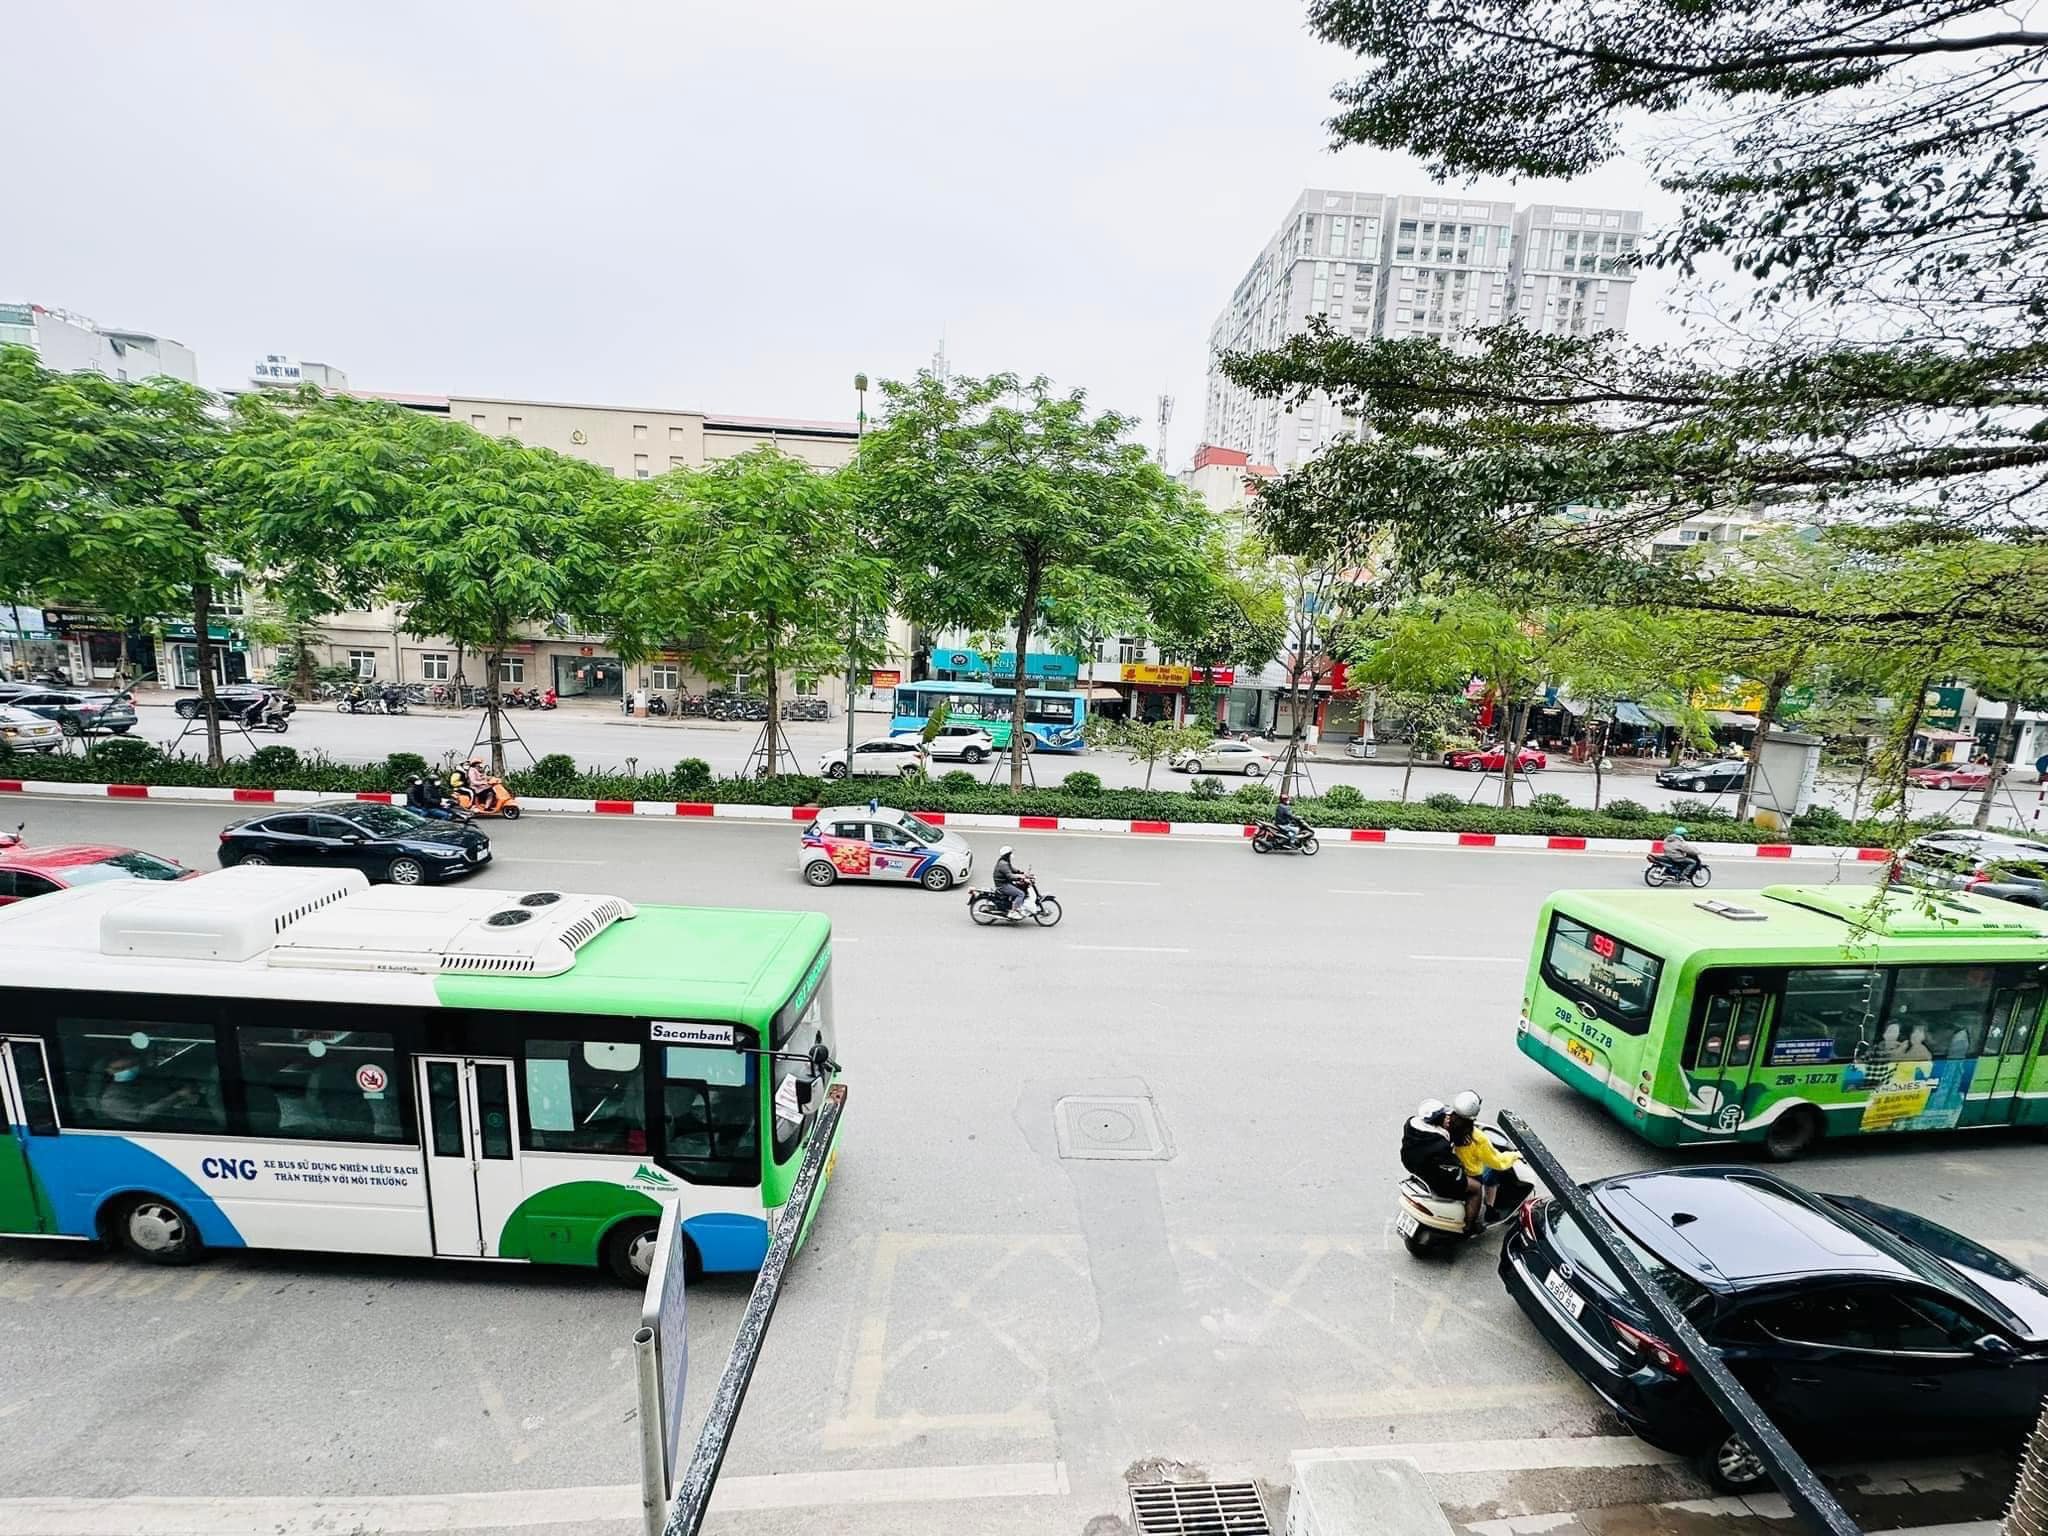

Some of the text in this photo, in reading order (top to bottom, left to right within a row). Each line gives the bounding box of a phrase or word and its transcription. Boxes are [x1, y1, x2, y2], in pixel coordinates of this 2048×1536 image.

[284, 367, 300, 378] NAM
[653, 1025, 731, 1042] Sacombank
[1555, 1006, 1572, 1024] 29B
[1581, 1022, 1613, 1049] 187.78
[1775, 1074, 1796, 1086] 29B
[1806, 1073, 1838, 1085] 187.78
[201, 1157, 258, 1181] CNG
[263, 1160, 276, 1169] XE
[278, 1161, 295, 1169] BUS
[311, 1162, 338, 1173] DỤNG
[339, 1162, 369, 1173] NHIÊN
[302, 1174, 330, 1184] THIỆN
